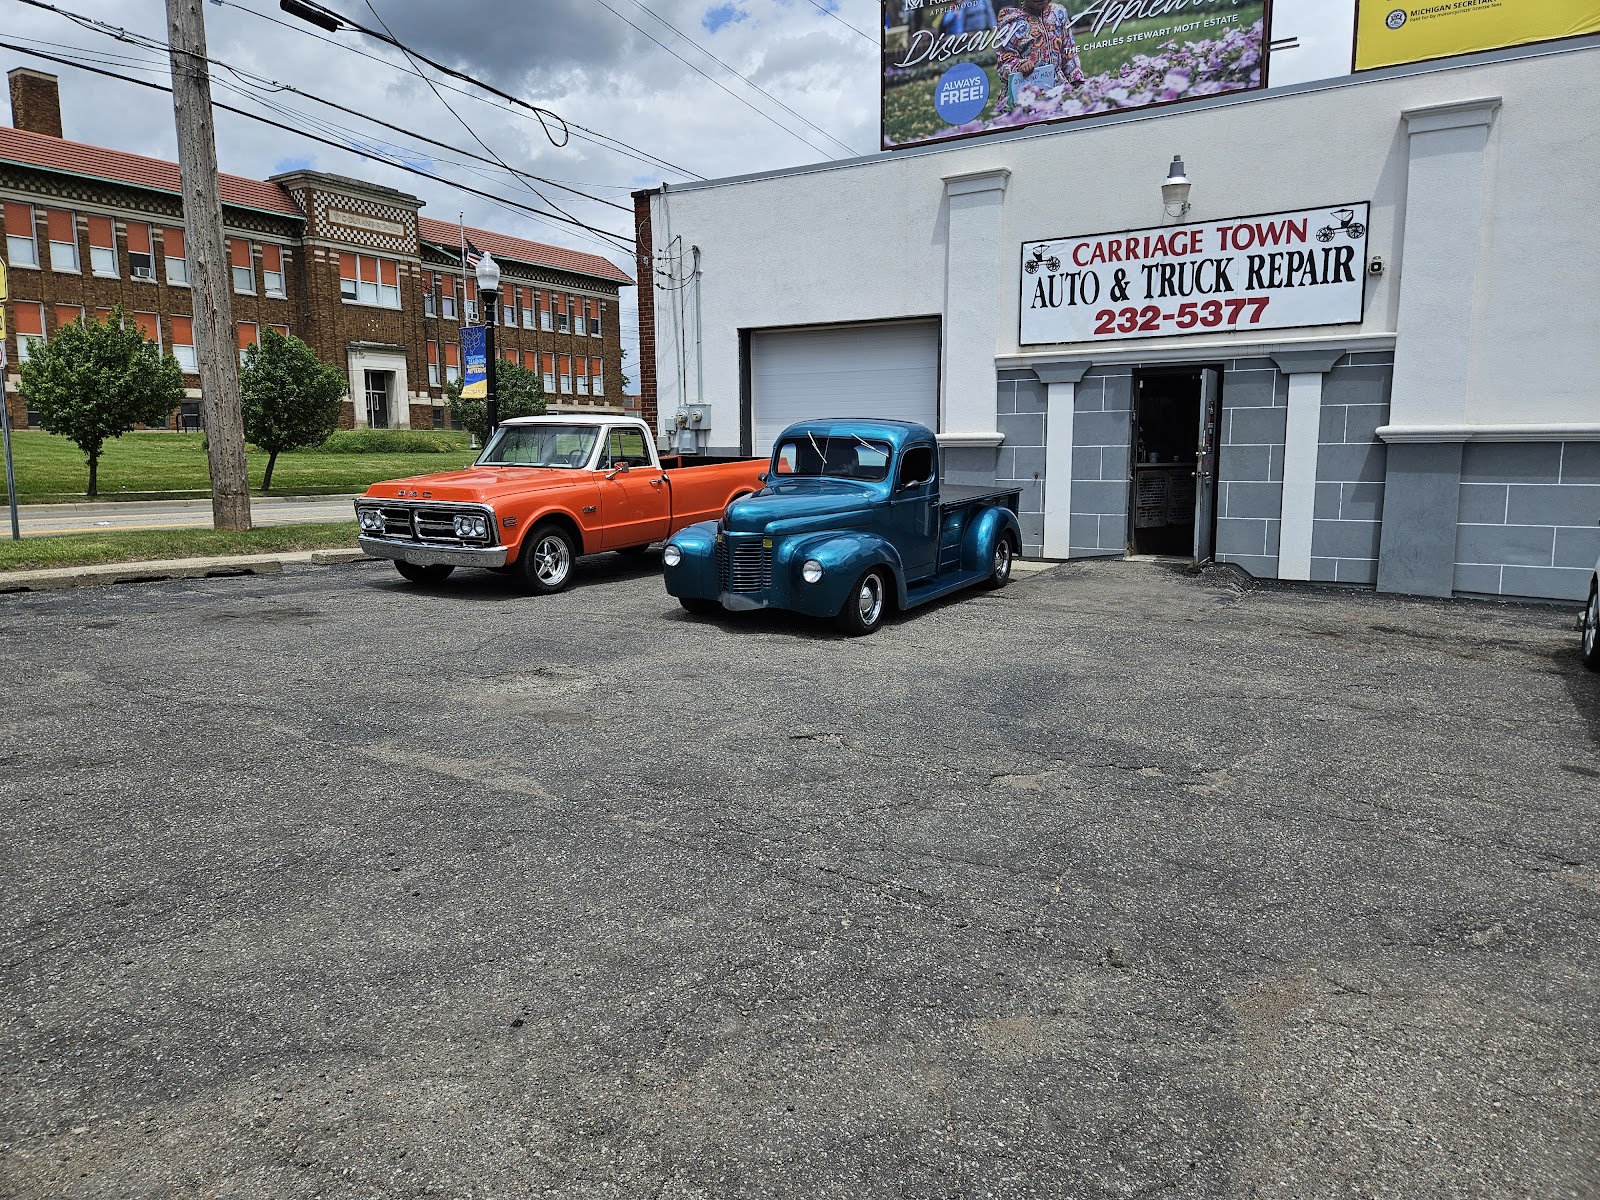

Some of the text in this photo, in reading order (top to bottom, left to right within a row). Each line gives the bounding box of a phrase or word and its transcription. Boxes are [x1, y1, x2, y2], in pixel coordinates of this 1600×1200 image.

[930, 0, 979, 16] APPLEWOOD
[1410, 4, 1452, 17] MICHIGAN
[894, 21, 1025, 68] Discover
[1064, 14, 1239, 54] THE CHARLES STEWART MOTT ESTATE
[940, 86, 984, 106] FREE!
[943, 76, 981, 91] ALWAYS
[1072, 217, 1308, 267] CARRIAGE TOWN
[1031, 245, 1356, 309] AUTO & TRUCK REPAIR
[1093, 296, 1270, 335] 232-5377
